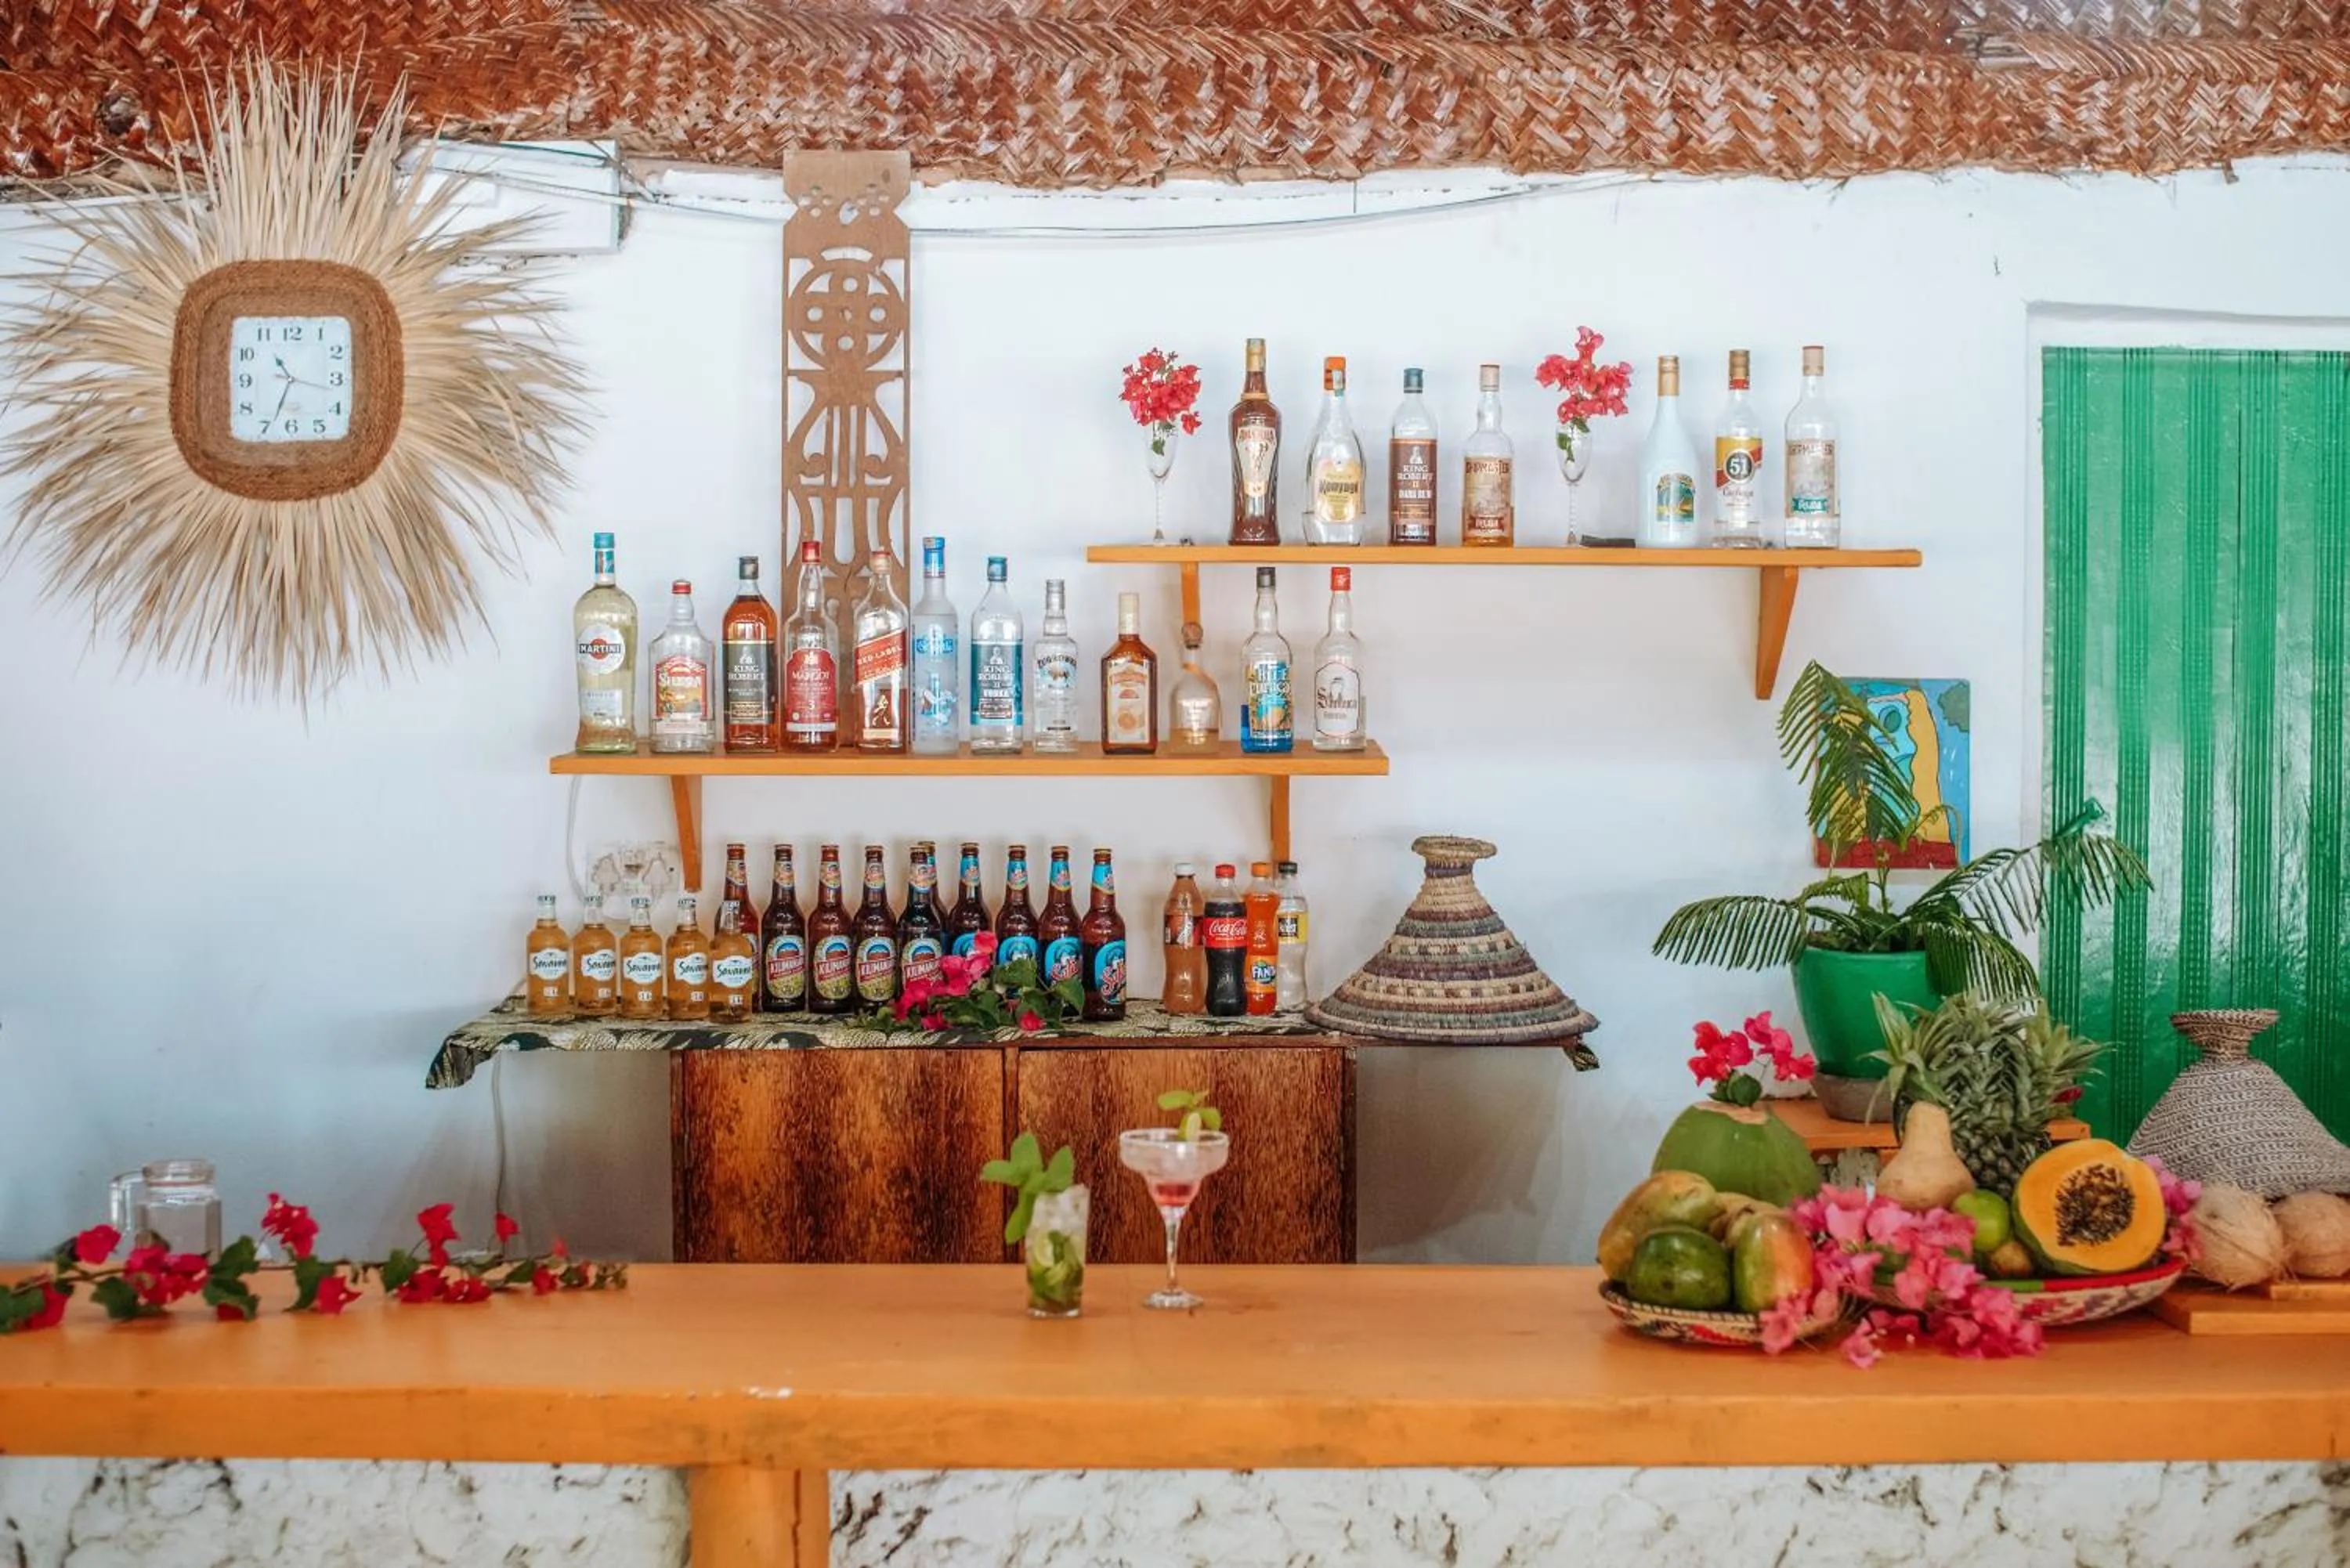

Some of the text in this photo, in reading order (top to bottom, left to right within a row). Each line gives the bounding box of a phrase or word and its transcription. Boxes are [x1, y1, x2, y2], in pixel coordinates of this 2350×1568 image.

[257, 327, 324, 341] 11 12 1
[240, 347, 255, 362] 10
[330, 345, 343, 359] 2
[239, 374, 252, 388] 9
[330, 372, 343, 386] 3
[240, 401, 253, 415] 8
[329, 401, 341, 415] 4
[259, 419, 326, 434] 7 6 5
[1729, 457, 1749, 475] 51
[580, 644, 620, 653] MARTINI
[809, 700, 815, 710] 3
